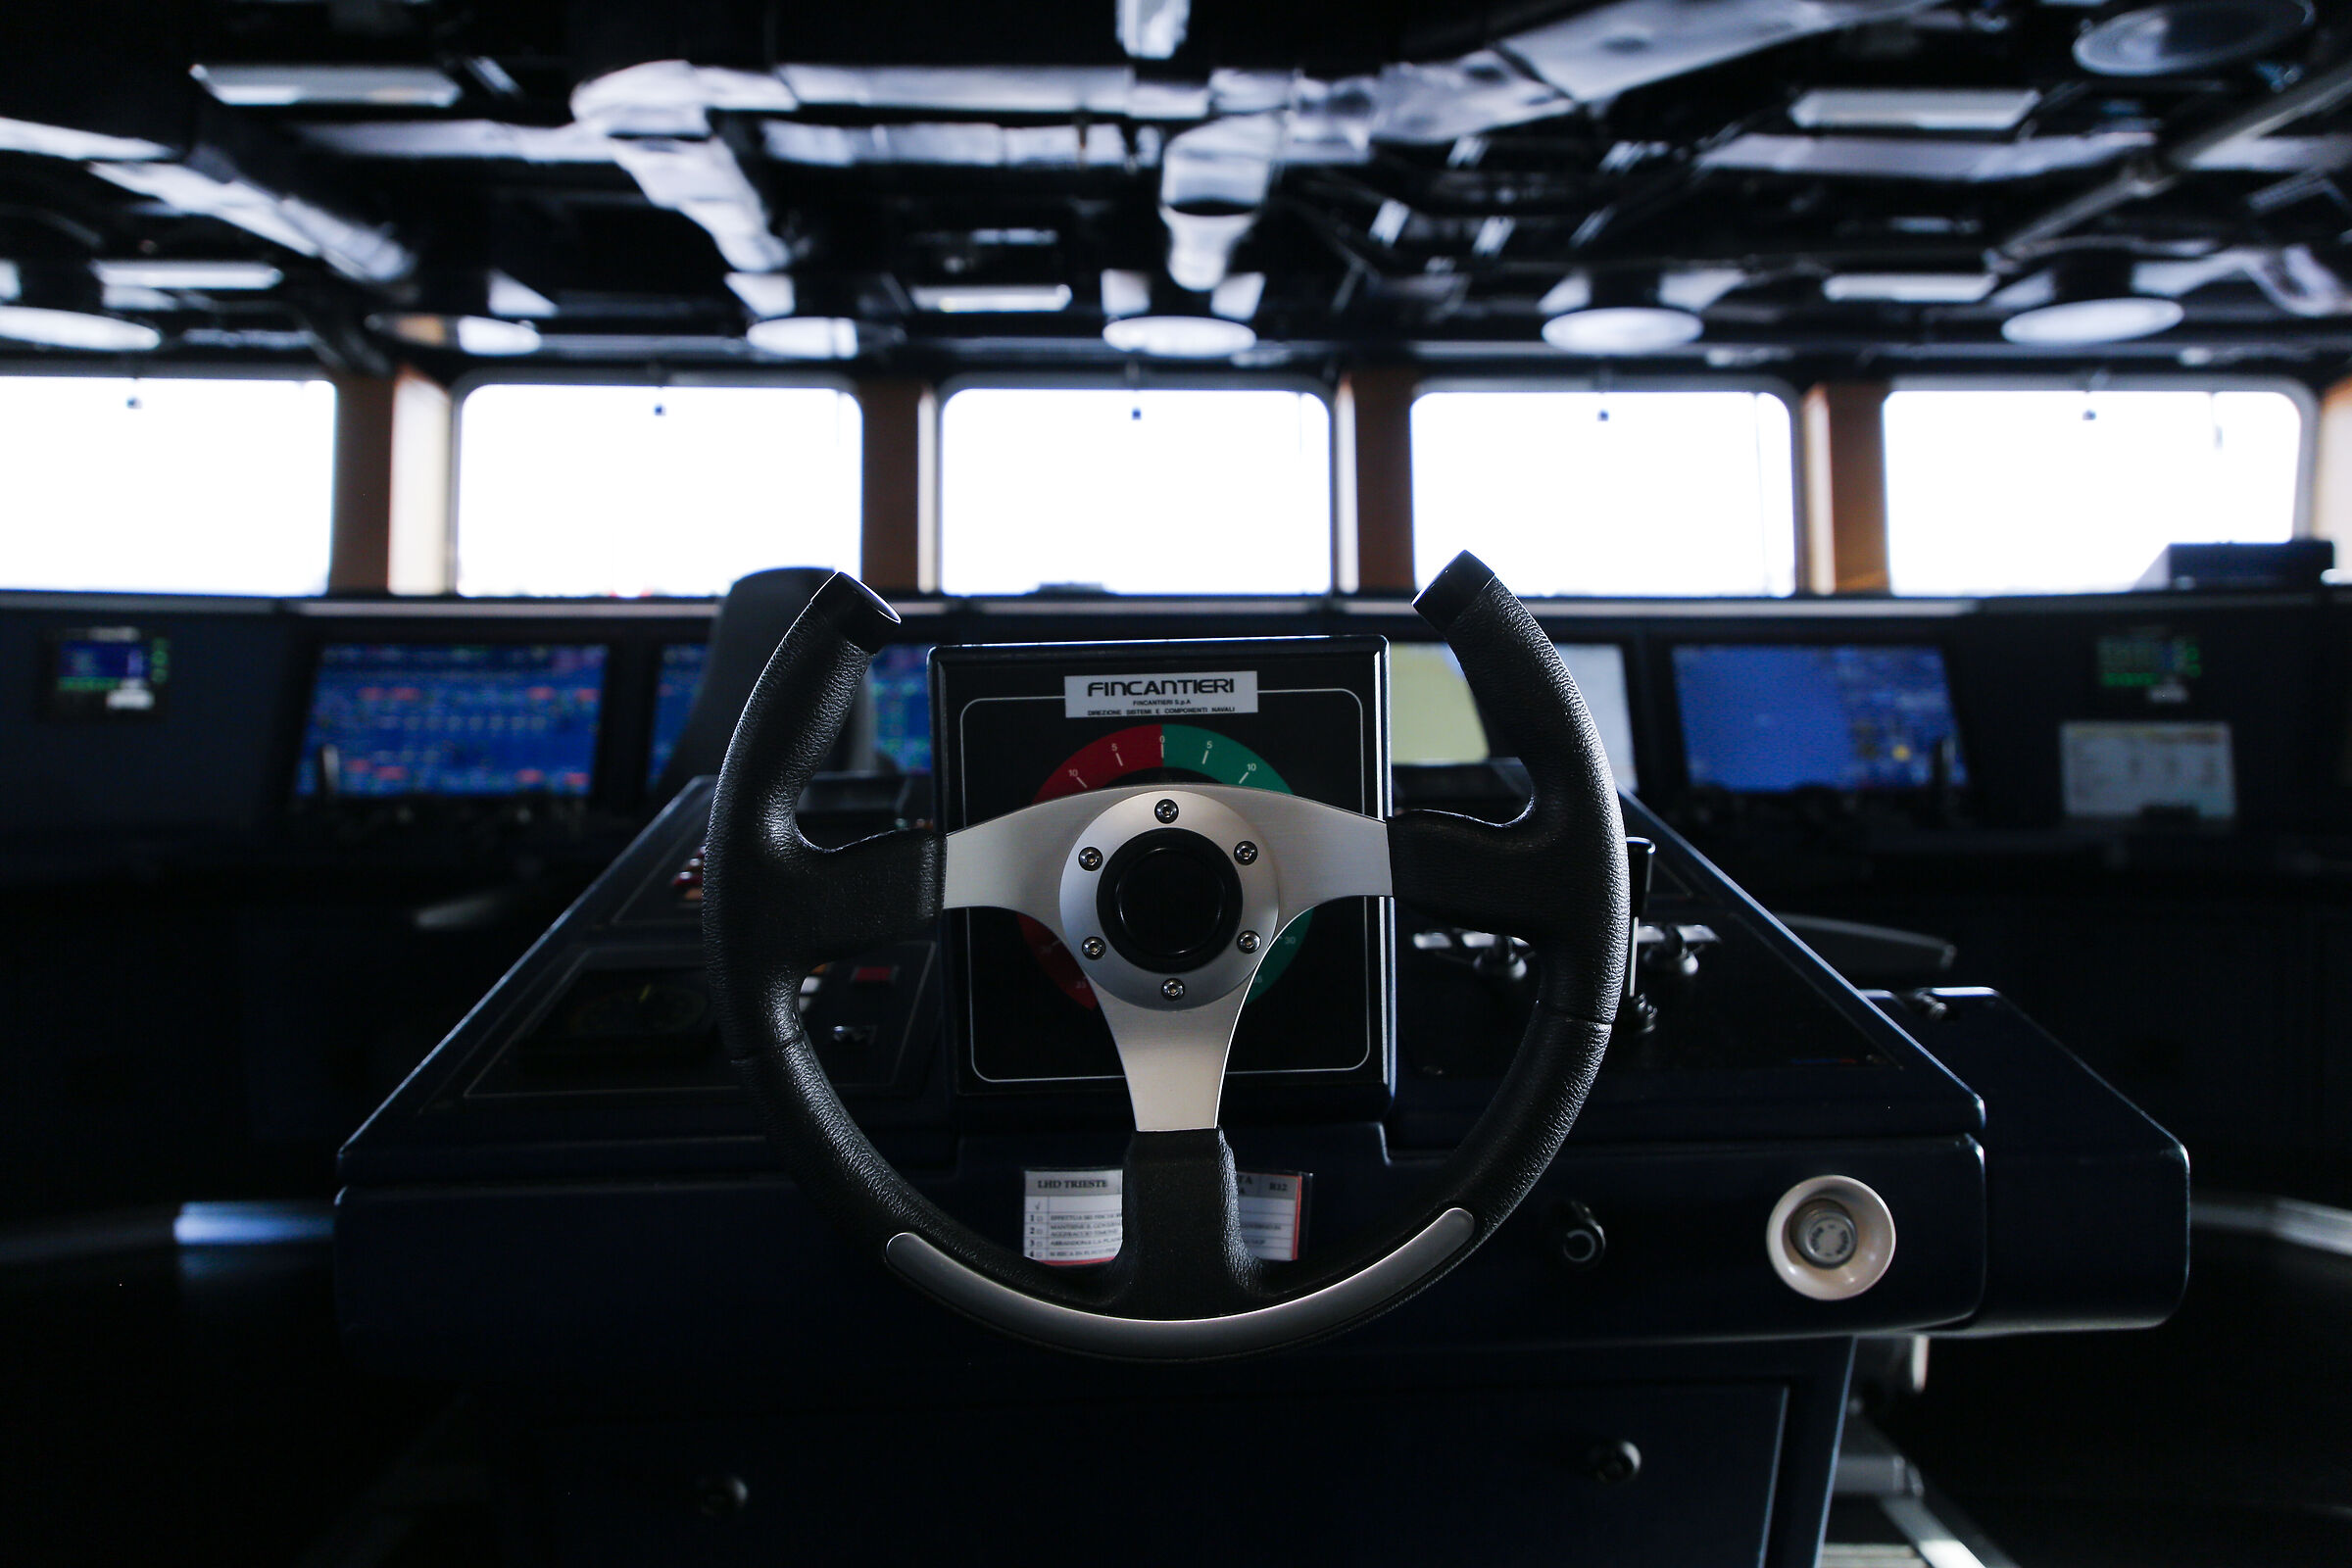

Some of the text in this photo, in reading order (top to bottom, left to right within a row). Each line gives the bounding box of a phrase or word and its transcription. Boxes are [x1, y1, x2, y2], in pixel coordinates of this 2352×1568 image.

[1088, 678, 1235, 697] FINCANTIERI
[1206, 741, 1213, 750] 5
[1037, 1179, 1107, 1189] LHD TRIESTE
